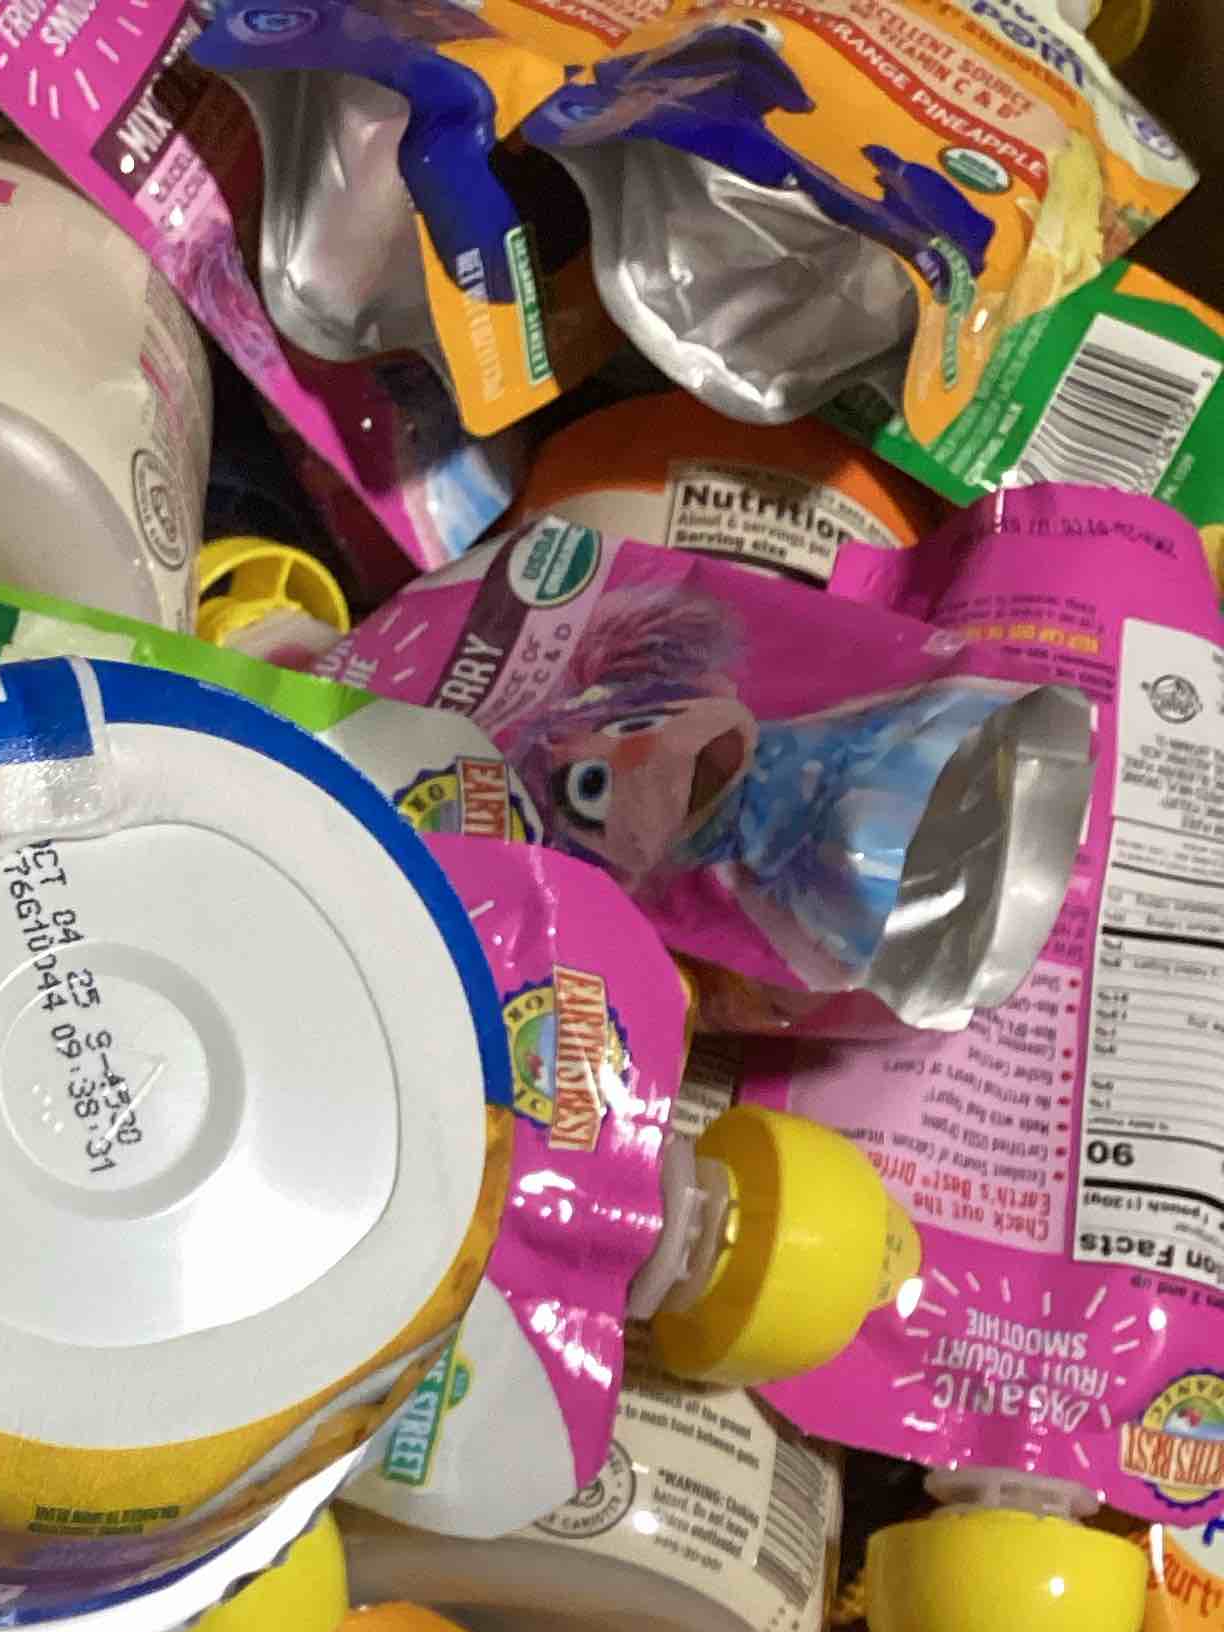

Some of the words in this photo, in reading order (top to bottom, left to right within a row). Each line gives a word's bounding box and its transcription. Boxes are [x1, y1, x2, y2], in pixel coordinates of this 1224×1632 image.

[906, 77, 1050, 191] PINEAPPLE
[678, 529, 745, 553] Serving
[751, 537, 788, 558] size
[48, 1019, 119, 1176] 09:38:31
[1017, 1115, 1052, 1137] Made
[1084, 1137, 1136, 1169] 90
[909, 1189, 945, 1218] the
[949, 1200, 986, 1226] out
[976, 1179, 1053, 1217] Earth's
[989, 1207, 1051, 1242] Check
[1076, 1230, 1176, 1268] Facts
[961, 1305, 1090, 1361] SMOOTHIE
[1036, 1356, 1109, 1397] FRUIT
